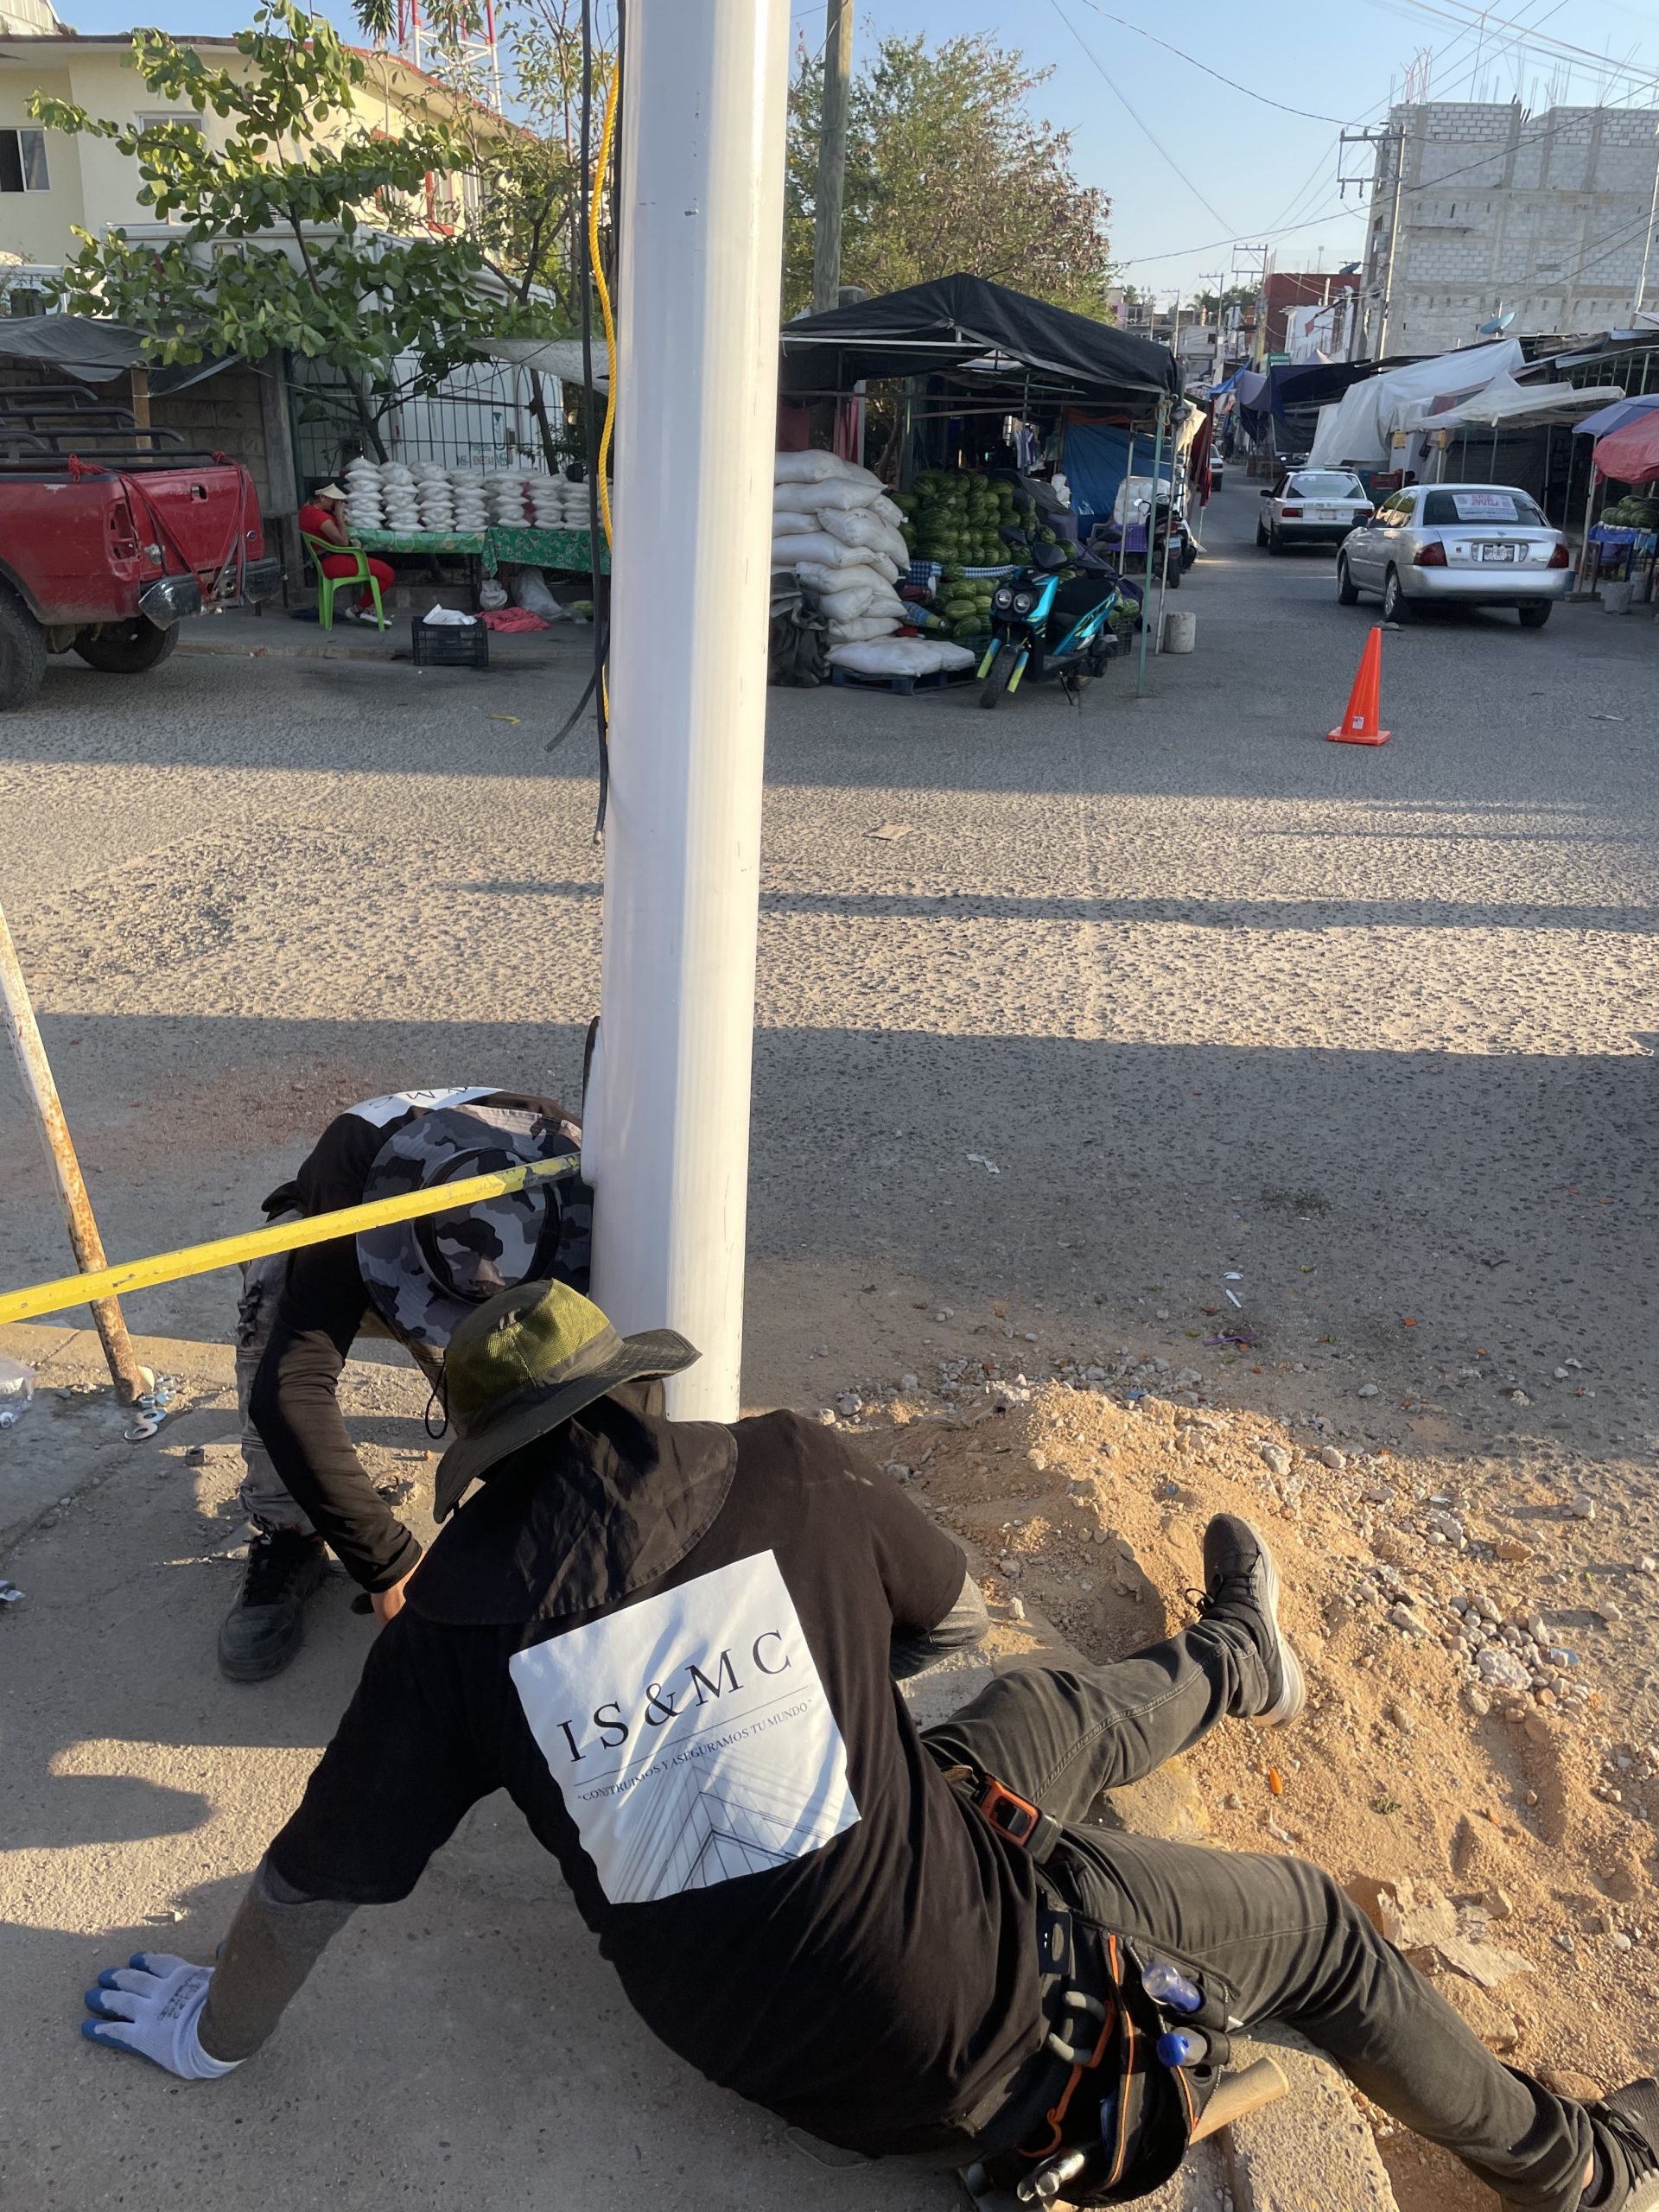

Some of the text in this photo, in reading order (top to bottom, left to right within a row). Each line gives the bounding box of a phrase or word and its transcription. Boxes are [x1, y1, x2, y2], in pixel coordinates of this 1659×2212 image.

[661, 1759, 670, 1770] Y
[670, 1728, 750, 1768] ASEGURAMOS
[749, 1720, 767, 1735] TU
